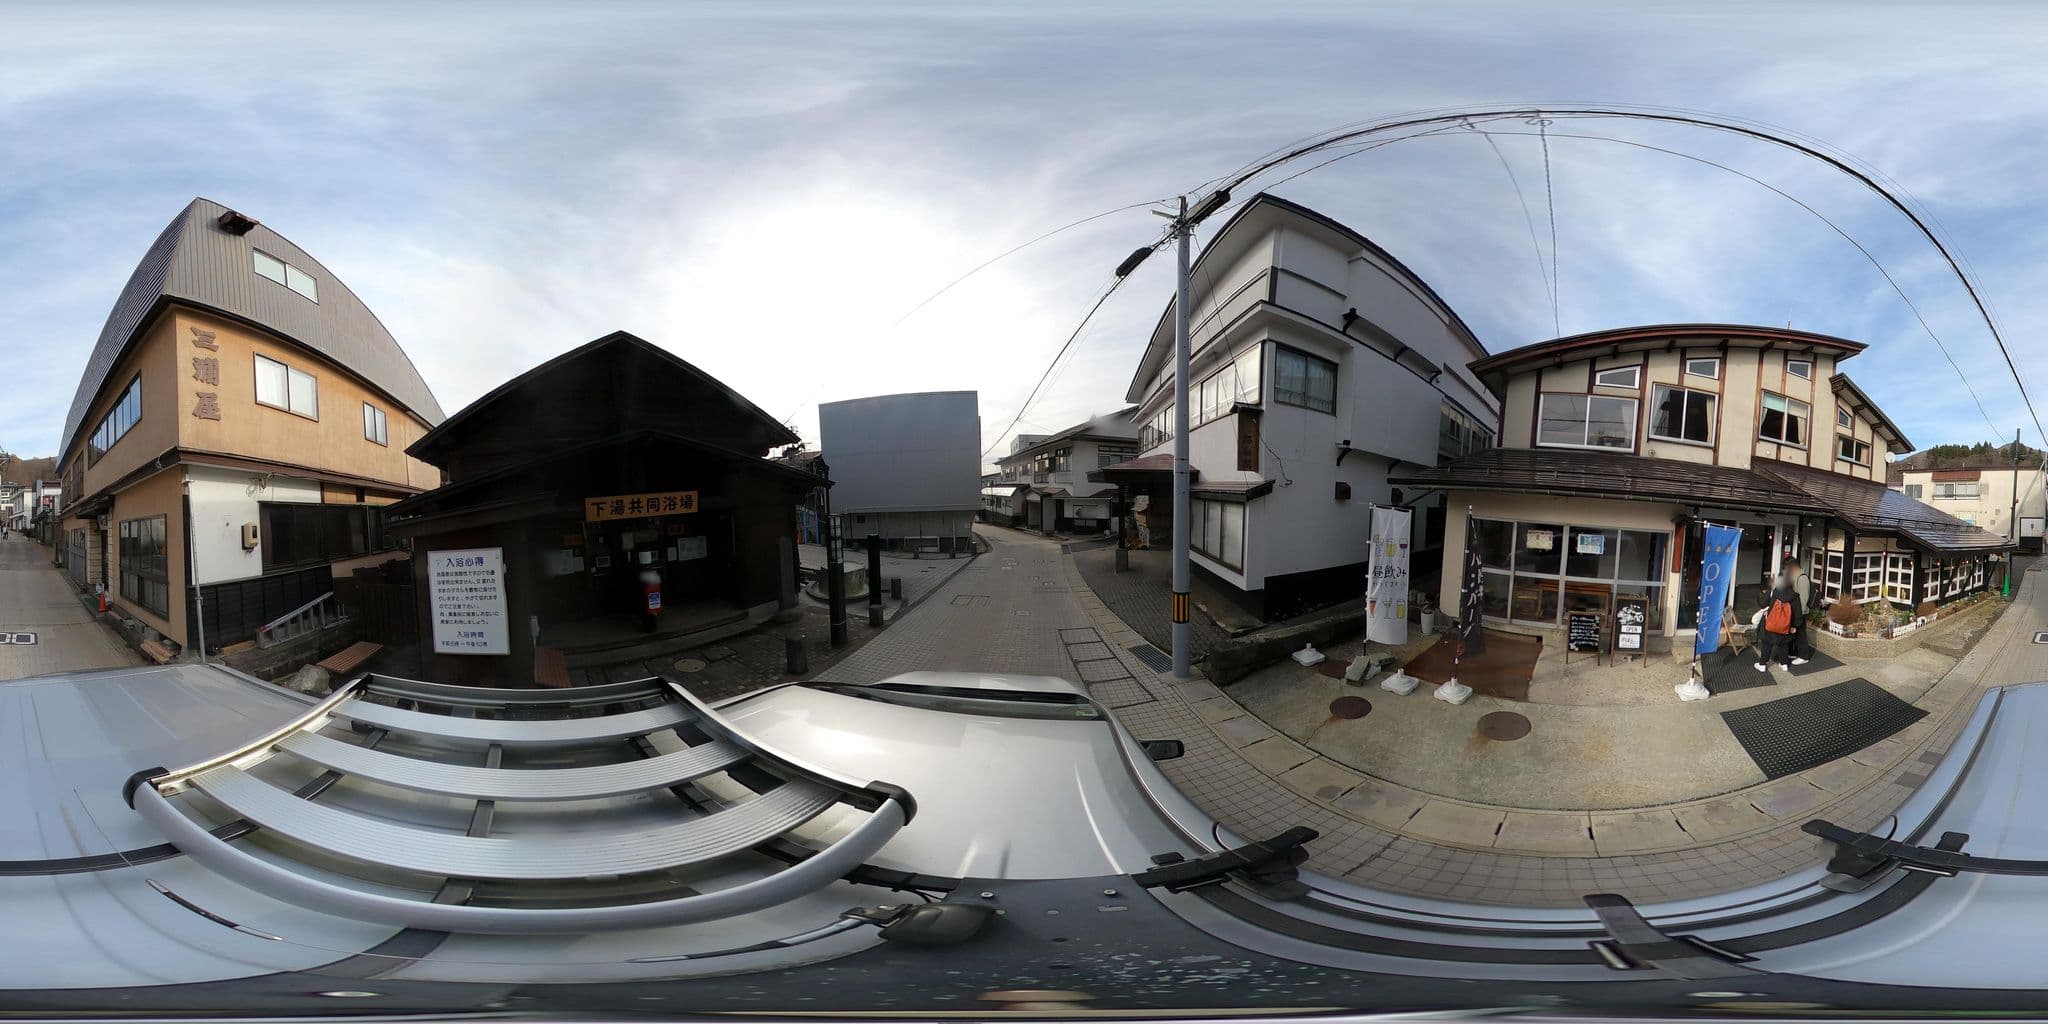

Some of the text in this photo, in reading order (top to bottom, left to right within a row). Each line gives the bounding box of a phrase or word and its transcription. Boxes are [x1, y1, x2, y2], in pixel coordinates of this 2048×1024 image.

[191, 327, 221, 421] 三浦屋
[591, 494, 694, 517] 下湯共同浴場
[446, 556, 485, 567] 入浴心得
[1372, 564, 1407, 579] 昼飲み
[1698, 562, 1720, 644] OPEN
